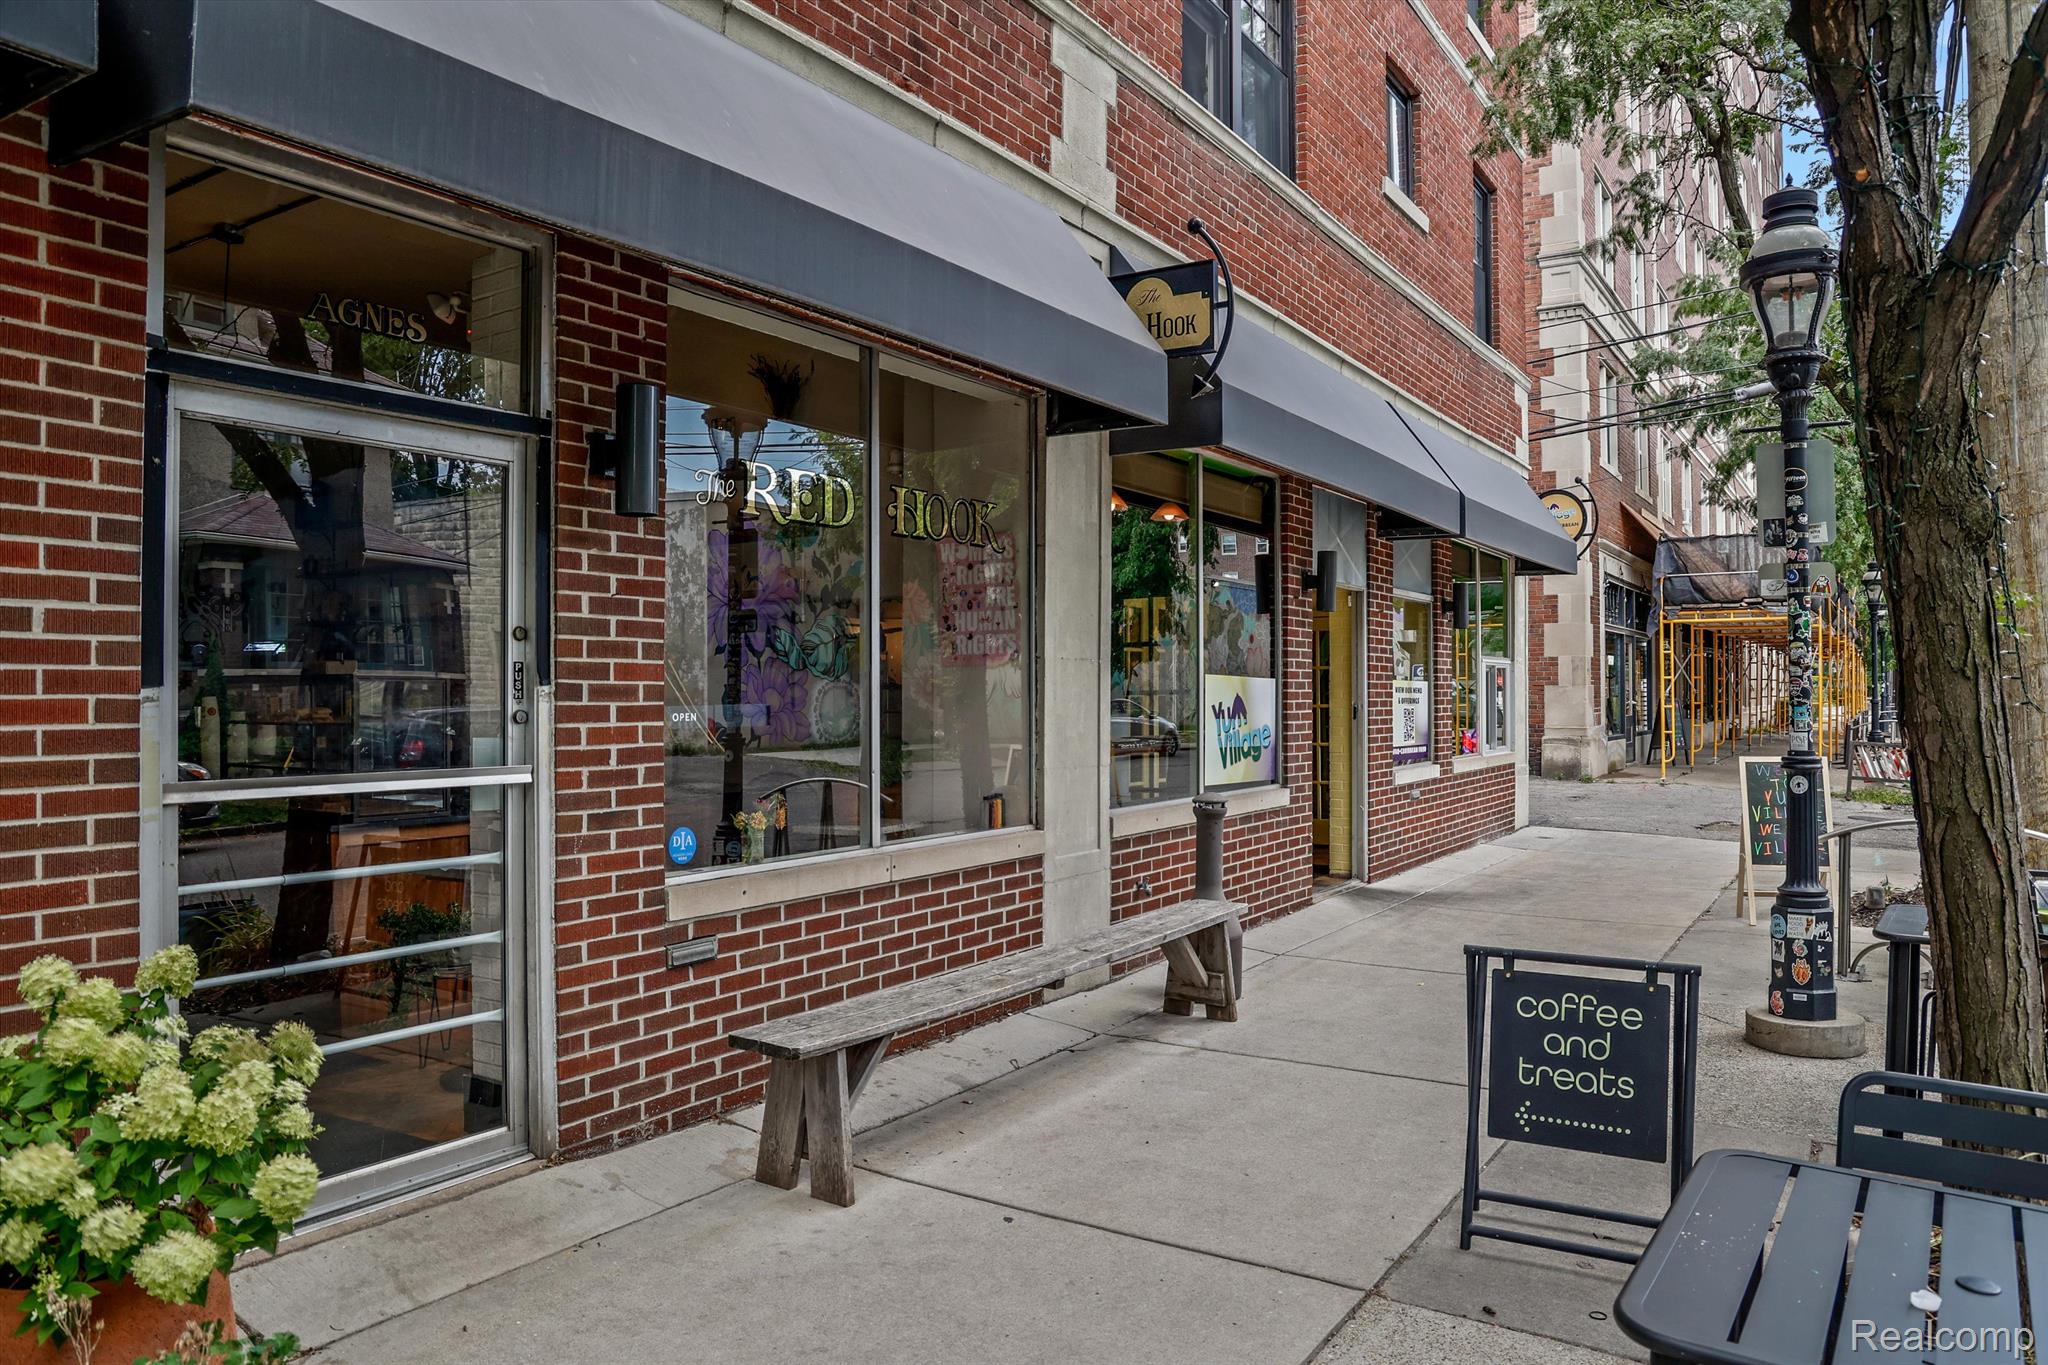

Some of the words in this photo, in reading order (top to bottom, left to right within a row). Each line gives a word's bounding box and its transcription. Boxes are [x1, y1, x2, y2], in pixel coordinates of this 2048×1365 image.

[1137, 288, 1161, 307] The
[308, 292, 428, 343] AGNES
[694, 468, 736, 505] The
[740, 460, 856, 528] RED
[887, 484, 1006, 554] HOOK
[514, 662, 522, 699] PUSH
[672, 712, 697, 723] OPEN
[1217, 723, 1271, 769] Village
[673, 831, 693, 850] DIA
[1516, 993, 1644, 1031] coffee
[1543, 1032, 1611, 1061] and
[1518, 1056, 1635, 1099] treats
